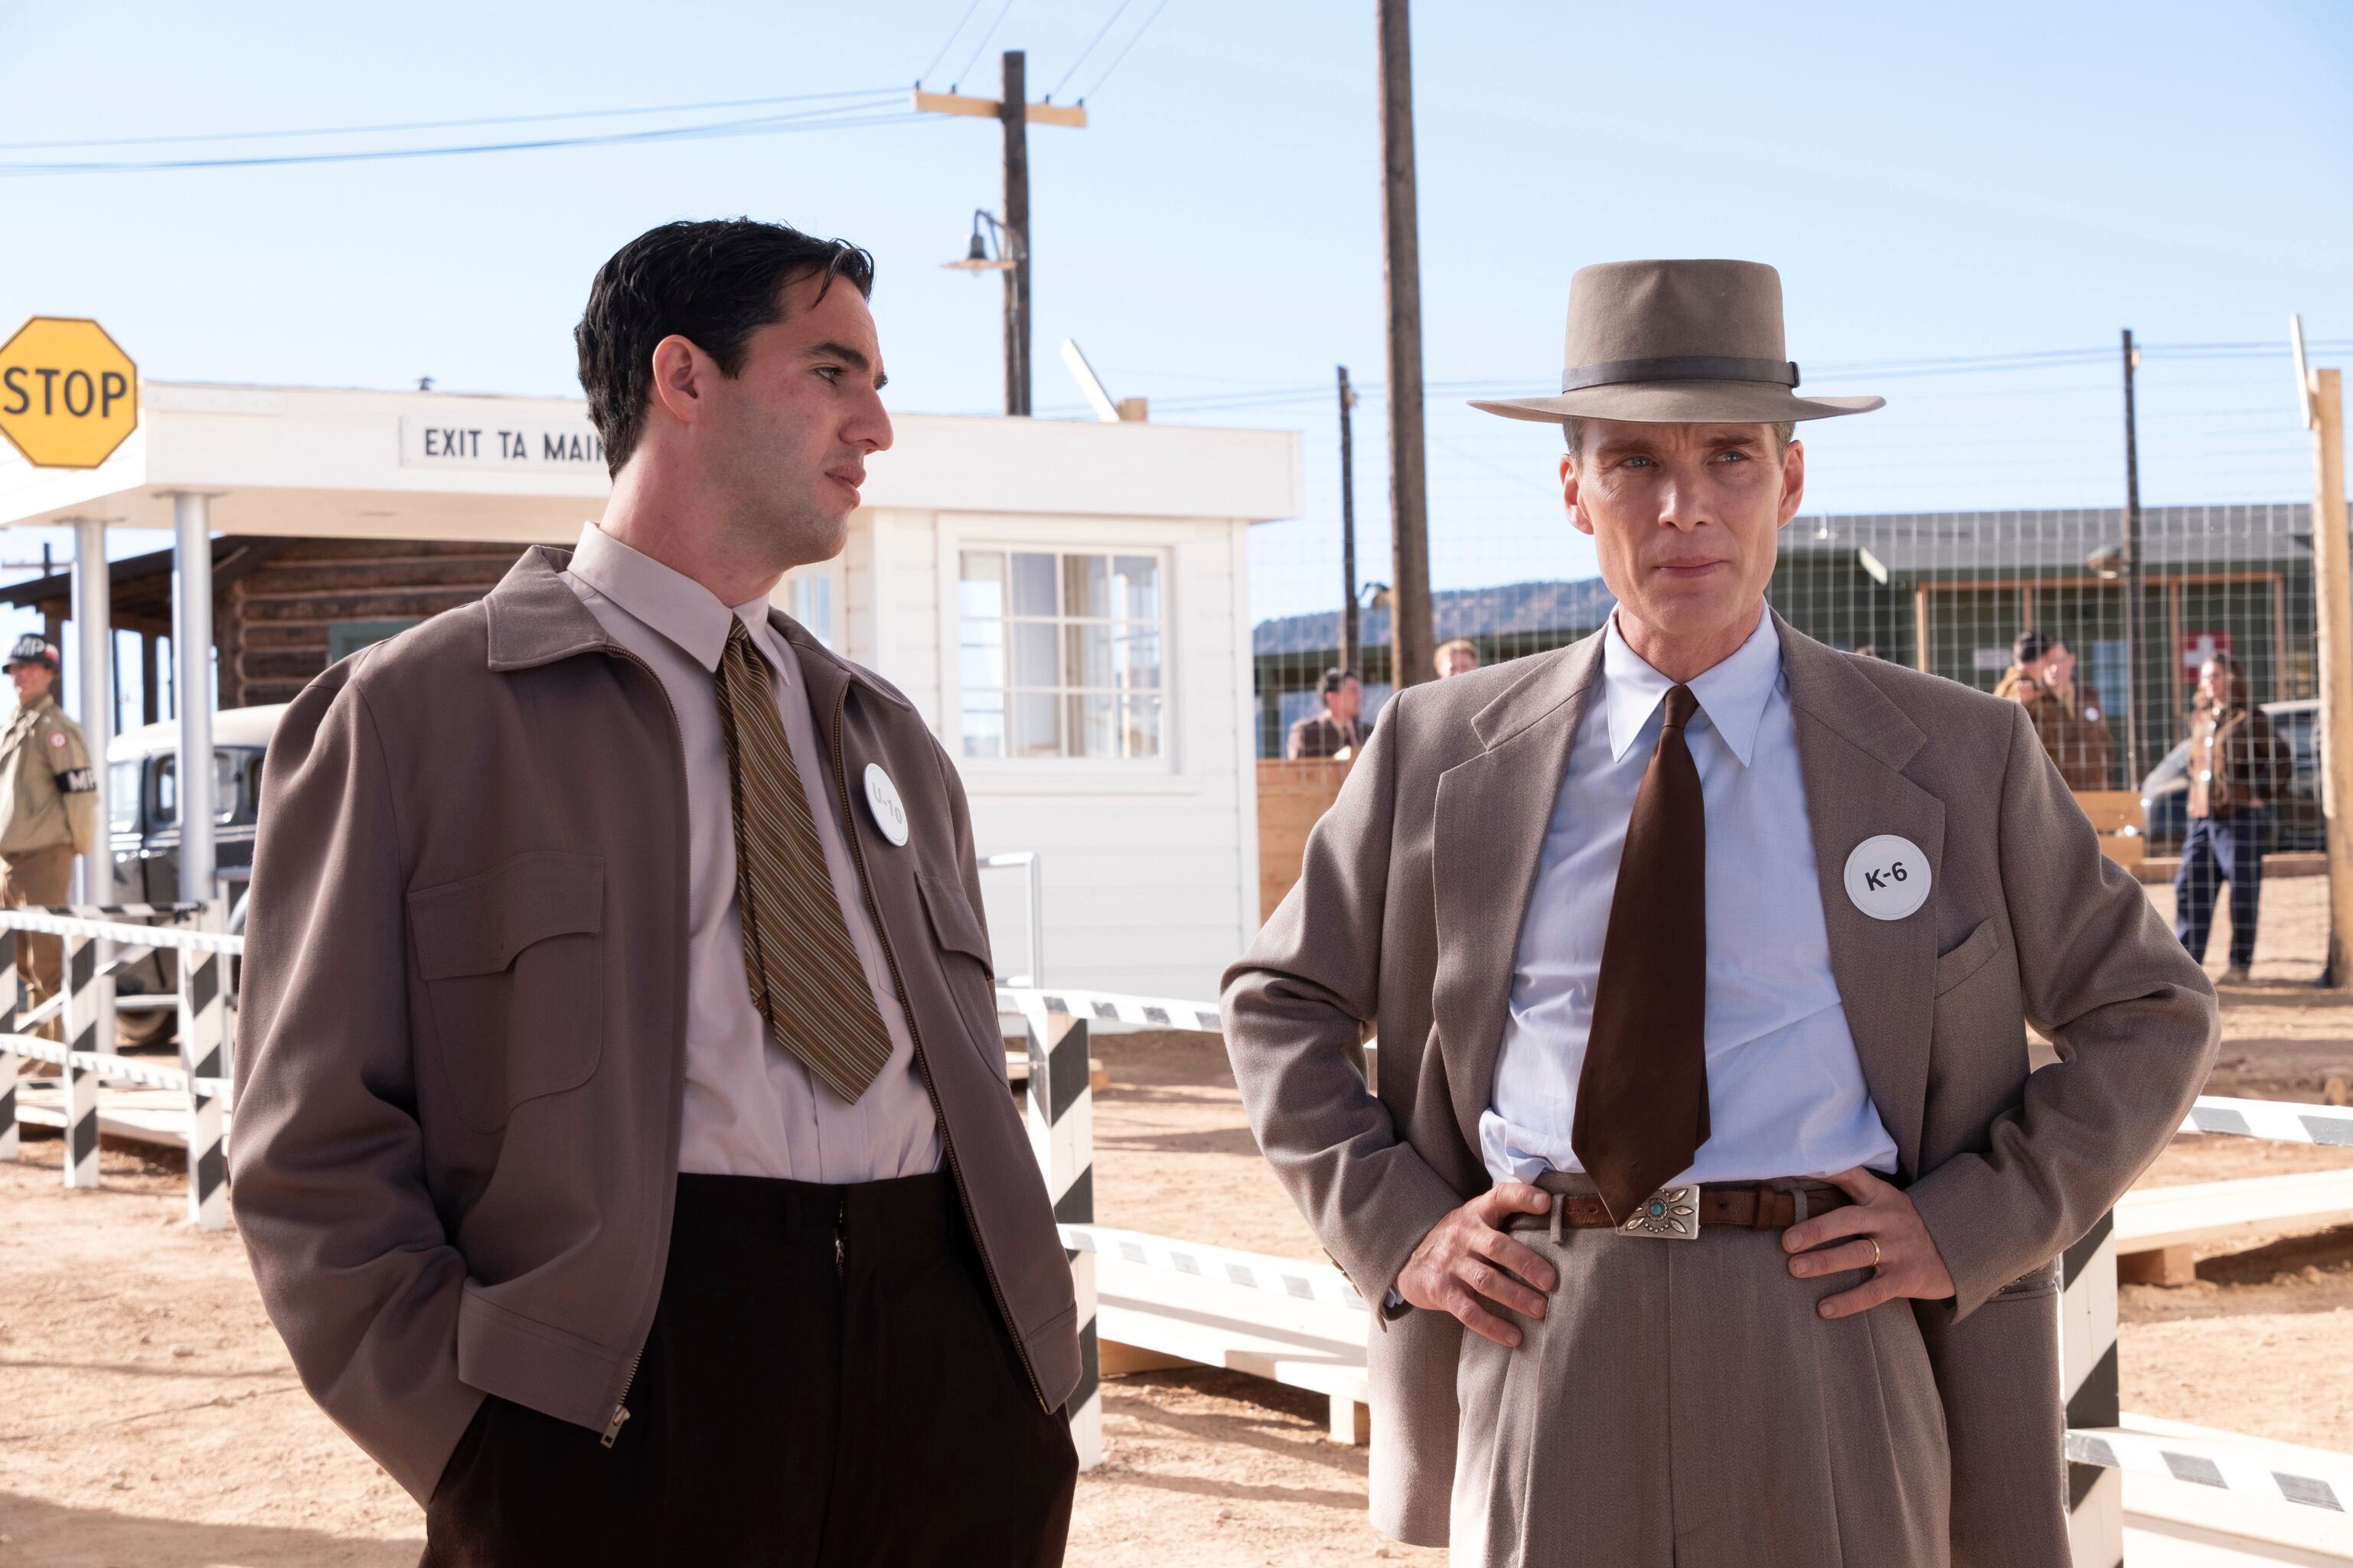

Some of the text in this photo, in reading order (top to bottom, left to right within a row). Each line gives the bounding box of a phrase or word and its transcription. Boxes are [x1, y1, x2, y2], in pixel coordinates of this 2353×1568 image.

[3, 367, 127, 418] STOP
[426, 429, 481, 457] EXIT
[498, 432, 527, 458] TA
[1865, 862, 1908, 892] K-6
